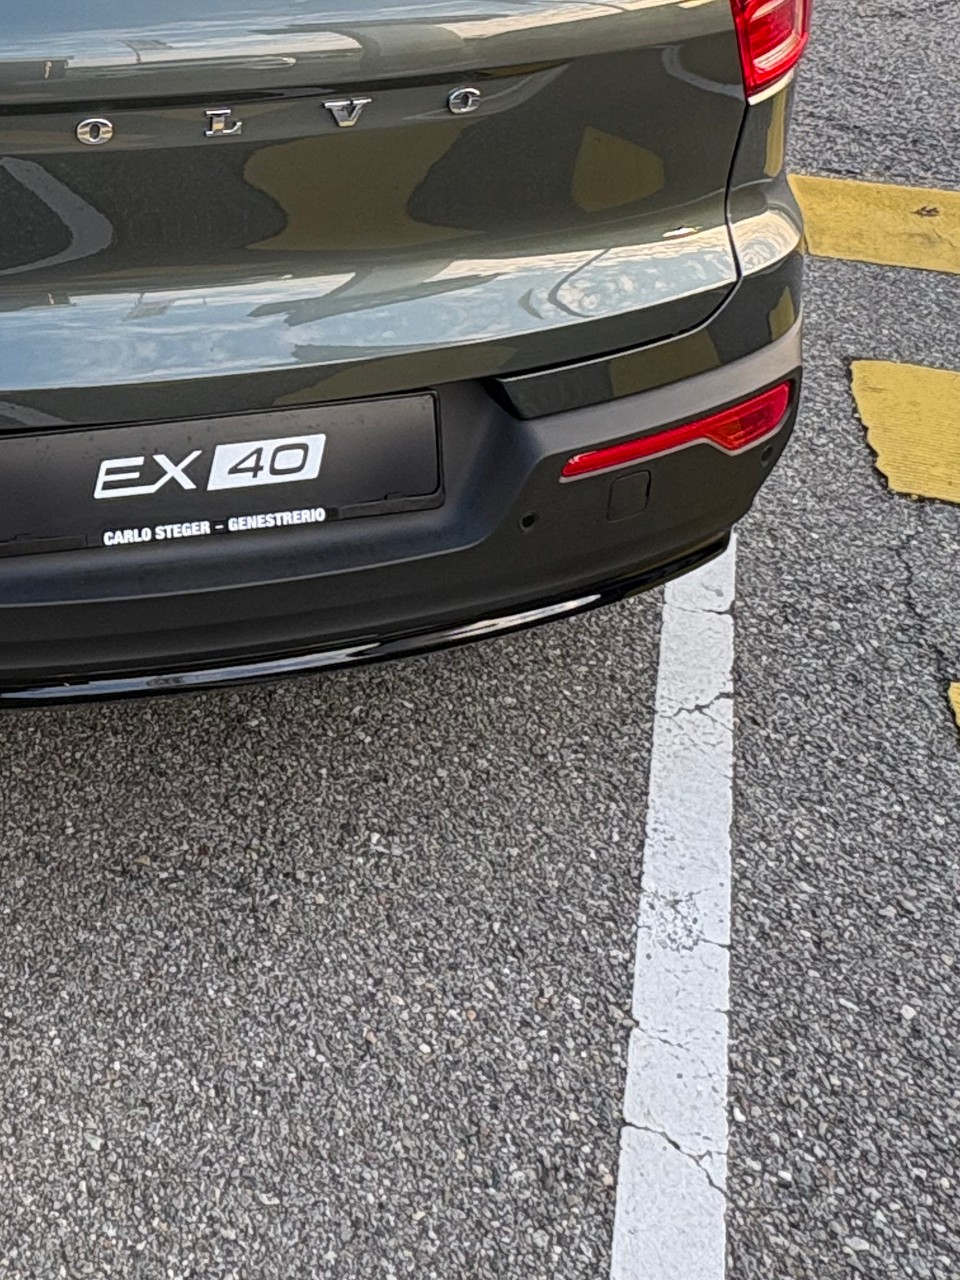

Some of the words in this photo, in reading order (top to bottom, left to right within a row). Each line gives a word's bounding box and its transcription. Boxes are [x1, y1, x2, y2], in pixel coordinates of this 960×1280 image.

[103, 527, 152, 546] CARLO
[155, 521, 211, 540] STEGER
[228, 507, 326, 532] GENESTRERIO
